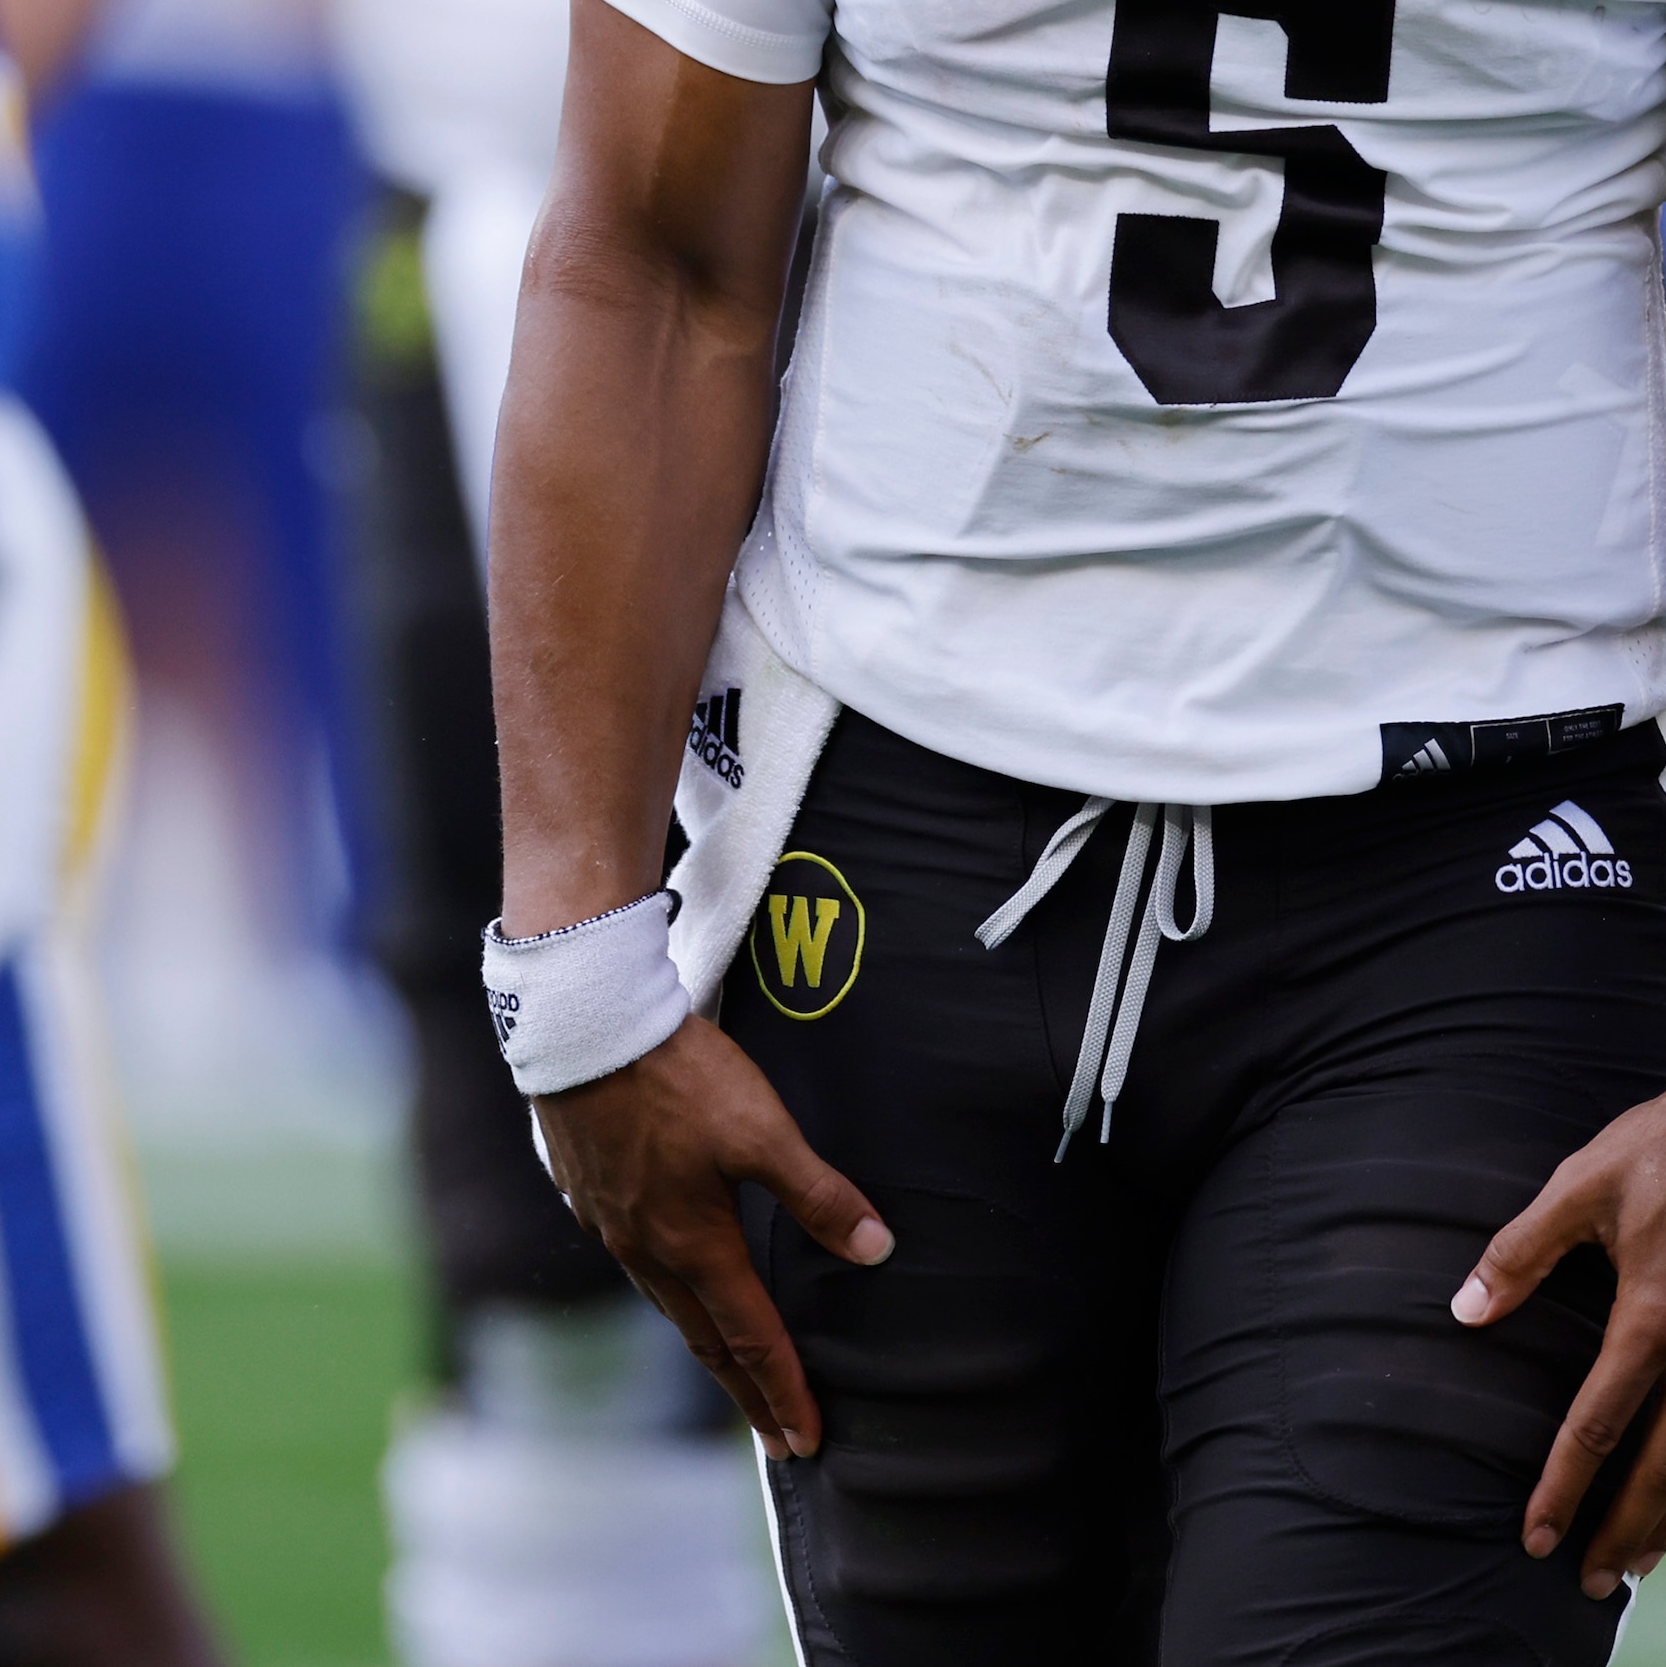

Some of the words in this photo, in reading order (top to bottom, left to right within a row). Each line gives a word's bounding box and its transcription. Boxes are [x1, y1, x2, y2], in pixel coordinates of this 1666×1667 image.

[689, 725, 745, 789] didas
[1495, 851, 1633, 893] adidas
[768, 894, 840, 988] W
